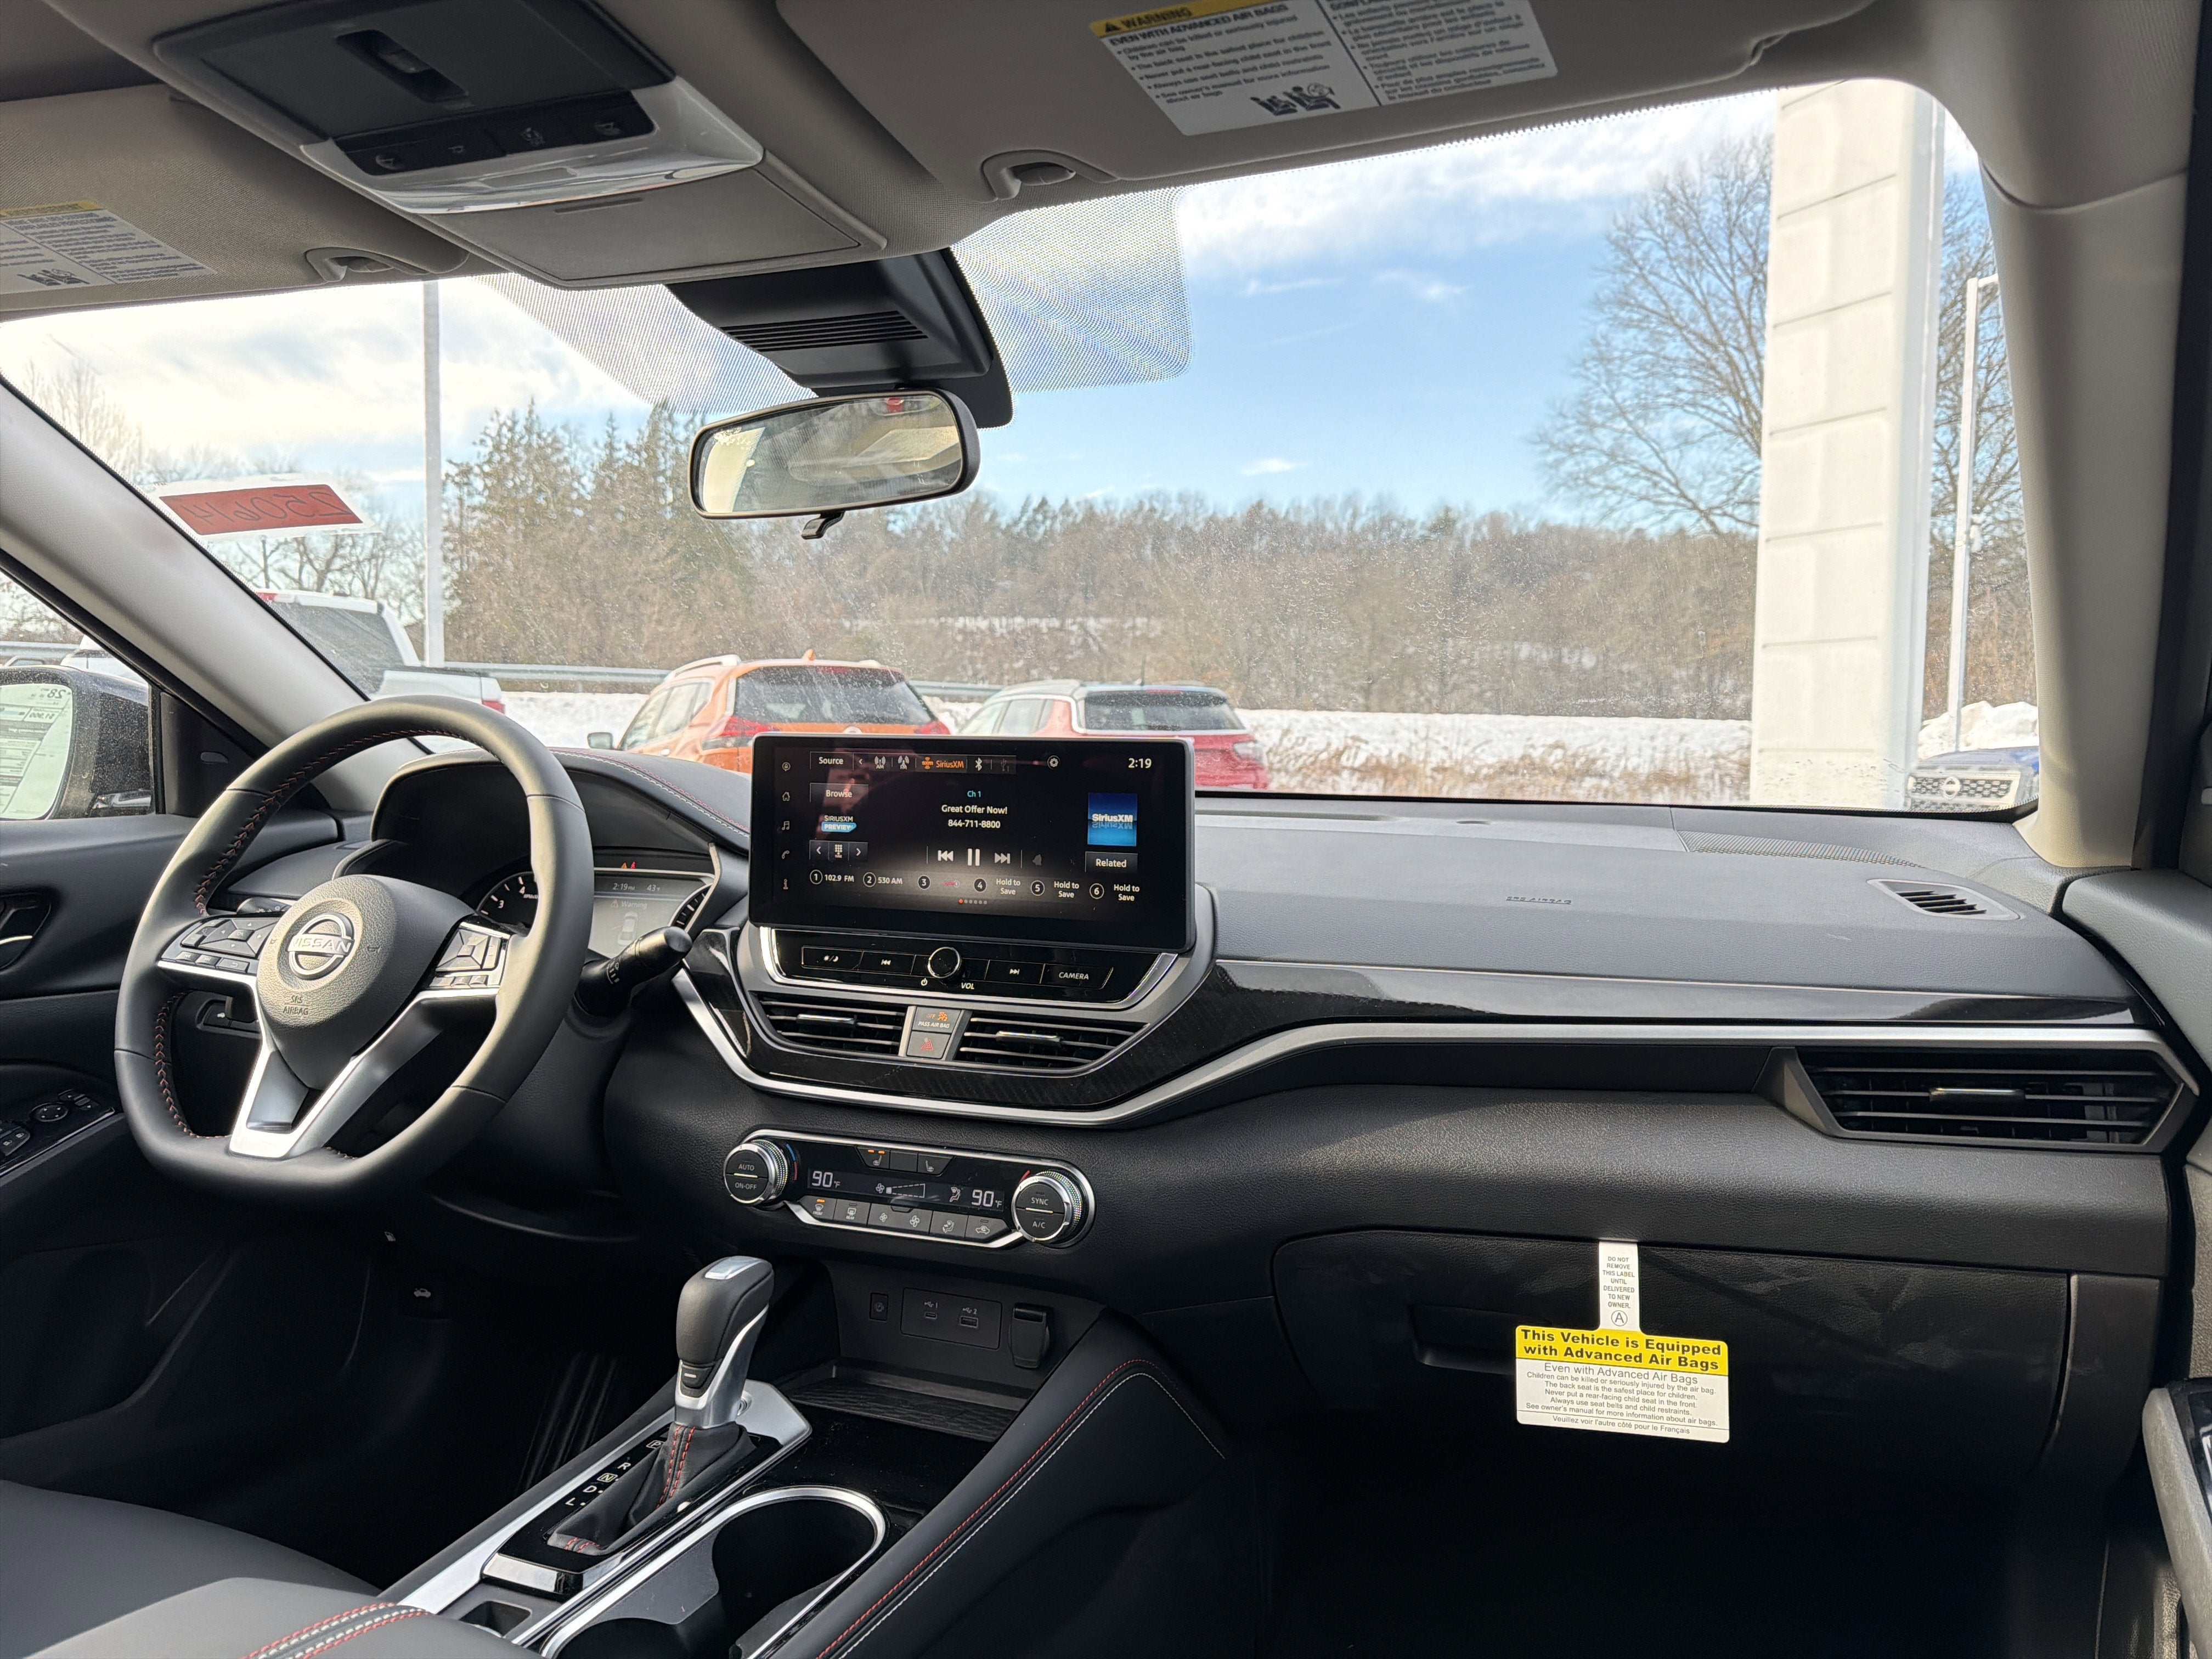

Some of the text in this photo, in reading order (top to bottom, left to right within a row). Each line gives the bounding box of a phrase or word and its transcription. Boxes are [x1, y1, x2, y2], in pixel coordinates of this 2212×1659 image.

[1120, 7, 1193, 27] WARNING
[819, 757, 844, 765] Source
[936, 760, 964, 769] SiriusXM
[1128, 758, 1152, 769] 2:19
[826, 789, 853, 798] Browse
[941, 805, 1008, 815] Great Offer Now!
[1092, 814, 1133, 822] SiriusXM
[948, 819, 1001, 828] 844-711-8800
[1096, 858, 1127, 868] Related
[1054, 881, 1070, 889] Hold
[518, 886, 526, 894] 4
[1118, 893, 1135, 901] Save
[498, 900, 504, 909] 3
[622, 901, 647, 910] Warning
[292, 938, 352, 952] NISSAN
[1059, 972, 1089, 980] CAMERA
[283, 1006, 308, 1015] AIRBAG
[1031, 1197, 1049, 1206] SYNC
[1032, 1221, 1046, 1229] A/C
[1615, 1312, 1624, 1323] A
[1521, 1329, 1721, 1356] This Vehicle is Equipped
[1523, 1345, 1719, 1372] with Advanced Air Bags
[1544, 1363, 1698, 1385] Even with Advanced Air Bags
[1527, 1371, 1555, 1379] Children
[1609, 1379, 1639, 1388] seriously
[1701, 1387, 1716, 1395] bag.
[1585, 1392, 1622, 1402] rear-facing
[1679, 1400, 1697, 1408] front.
[1550, 1397, 1574, 1406] Always
[1657, 1407, 1691, 1415] restraints.
[1626, 1411, 1664, 1421] information
[1666, 1415, 1686, 1423] about
[1699, 1418, 1718, 1426] bags.
[1553, 1415, 1579, 1424] Veuillez
[1660, 1425, 1690, 1434] Français
[617, 1462, 631, 1470] R
[583, 1485, 597, 1493] D
[565, 1497, 576, 1506] L
